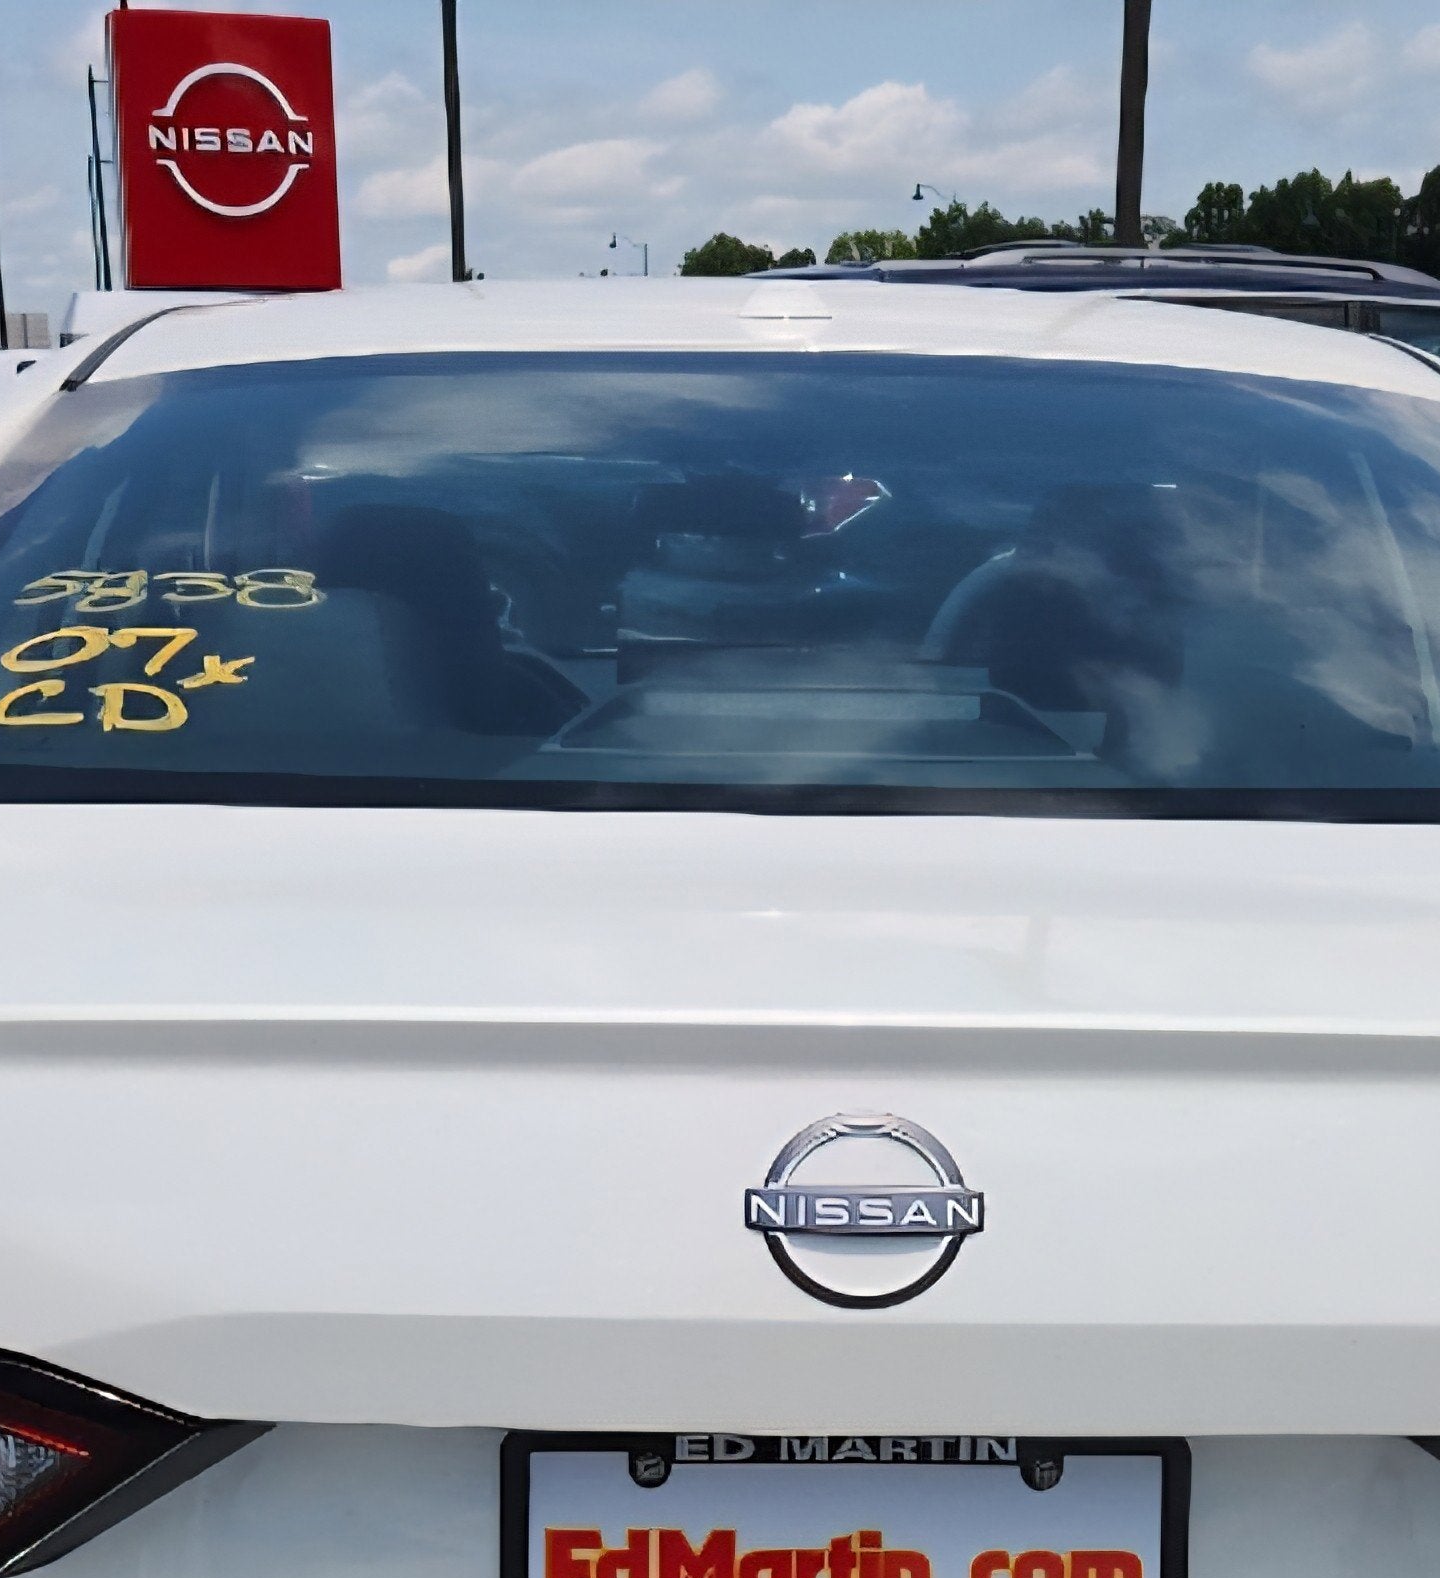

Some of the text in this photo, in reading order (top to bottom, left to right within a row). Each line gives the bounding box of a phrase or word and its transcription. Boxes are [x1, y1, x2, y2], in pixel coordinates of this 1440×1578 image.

[148, 124, 313, 154] NISSAN
[750, 1195, 980, 1226] NISSAN
[675, 1435, 1017, 1462] ED MARTIN
